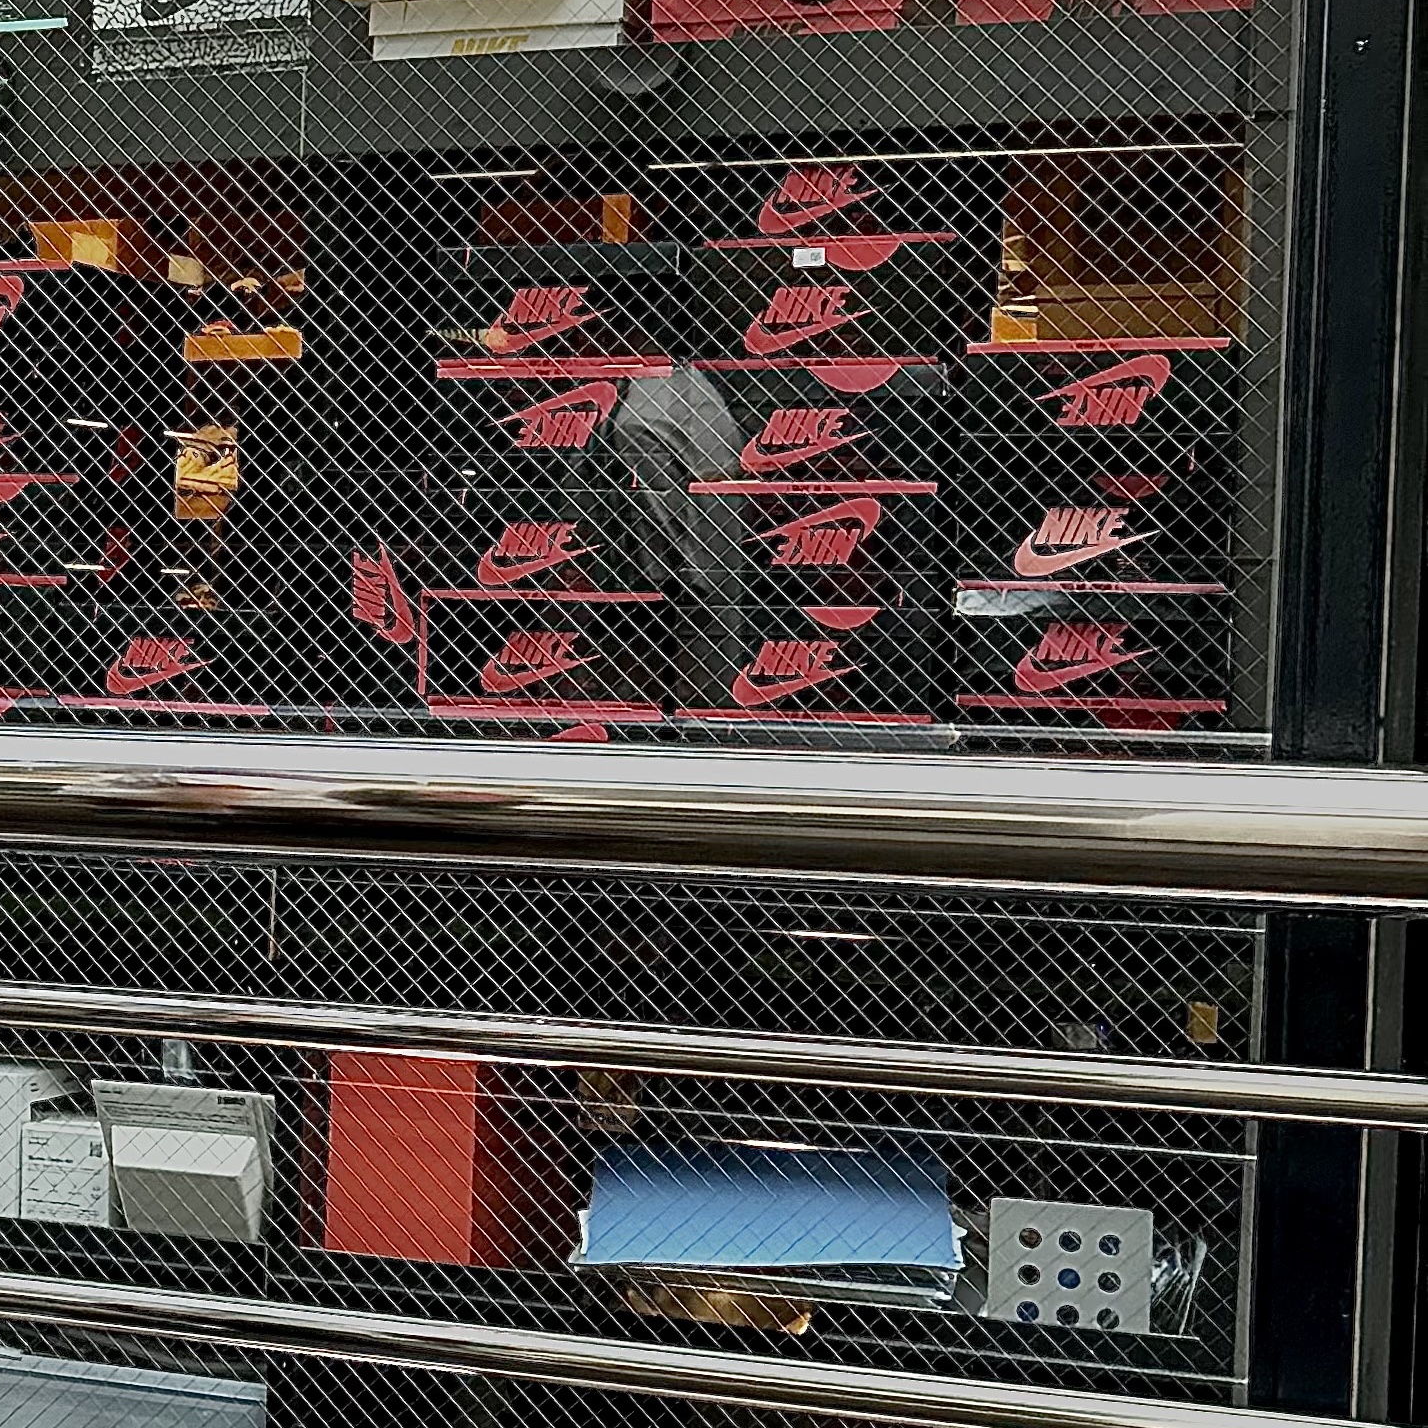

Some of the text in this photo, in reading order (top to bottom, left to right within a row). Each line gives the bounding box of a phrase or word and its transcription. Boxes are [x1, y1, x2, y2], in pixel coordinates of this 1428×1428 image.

[775, 165, 858, 203] NIKE
[507, 287, 588, 323] NIKE
[763, 286, 850, 323] NIKE
[1056, 386, 1150, 426] NIKE
[514, 411, 598, 448] NIKE
[760, 408, 850, 445] NIKE
[494, 522, 577, 557] NIKE
[1035, 507, 1129, 545] NIKE
[771, 528, 861, 565] NIKE
[123, 637, 194, 668] NIKE
[498, 632, 580, 664] NIKE
[749, 641, 840, 676] NIKE
[1036, 623, 1129, 661] NIKE
